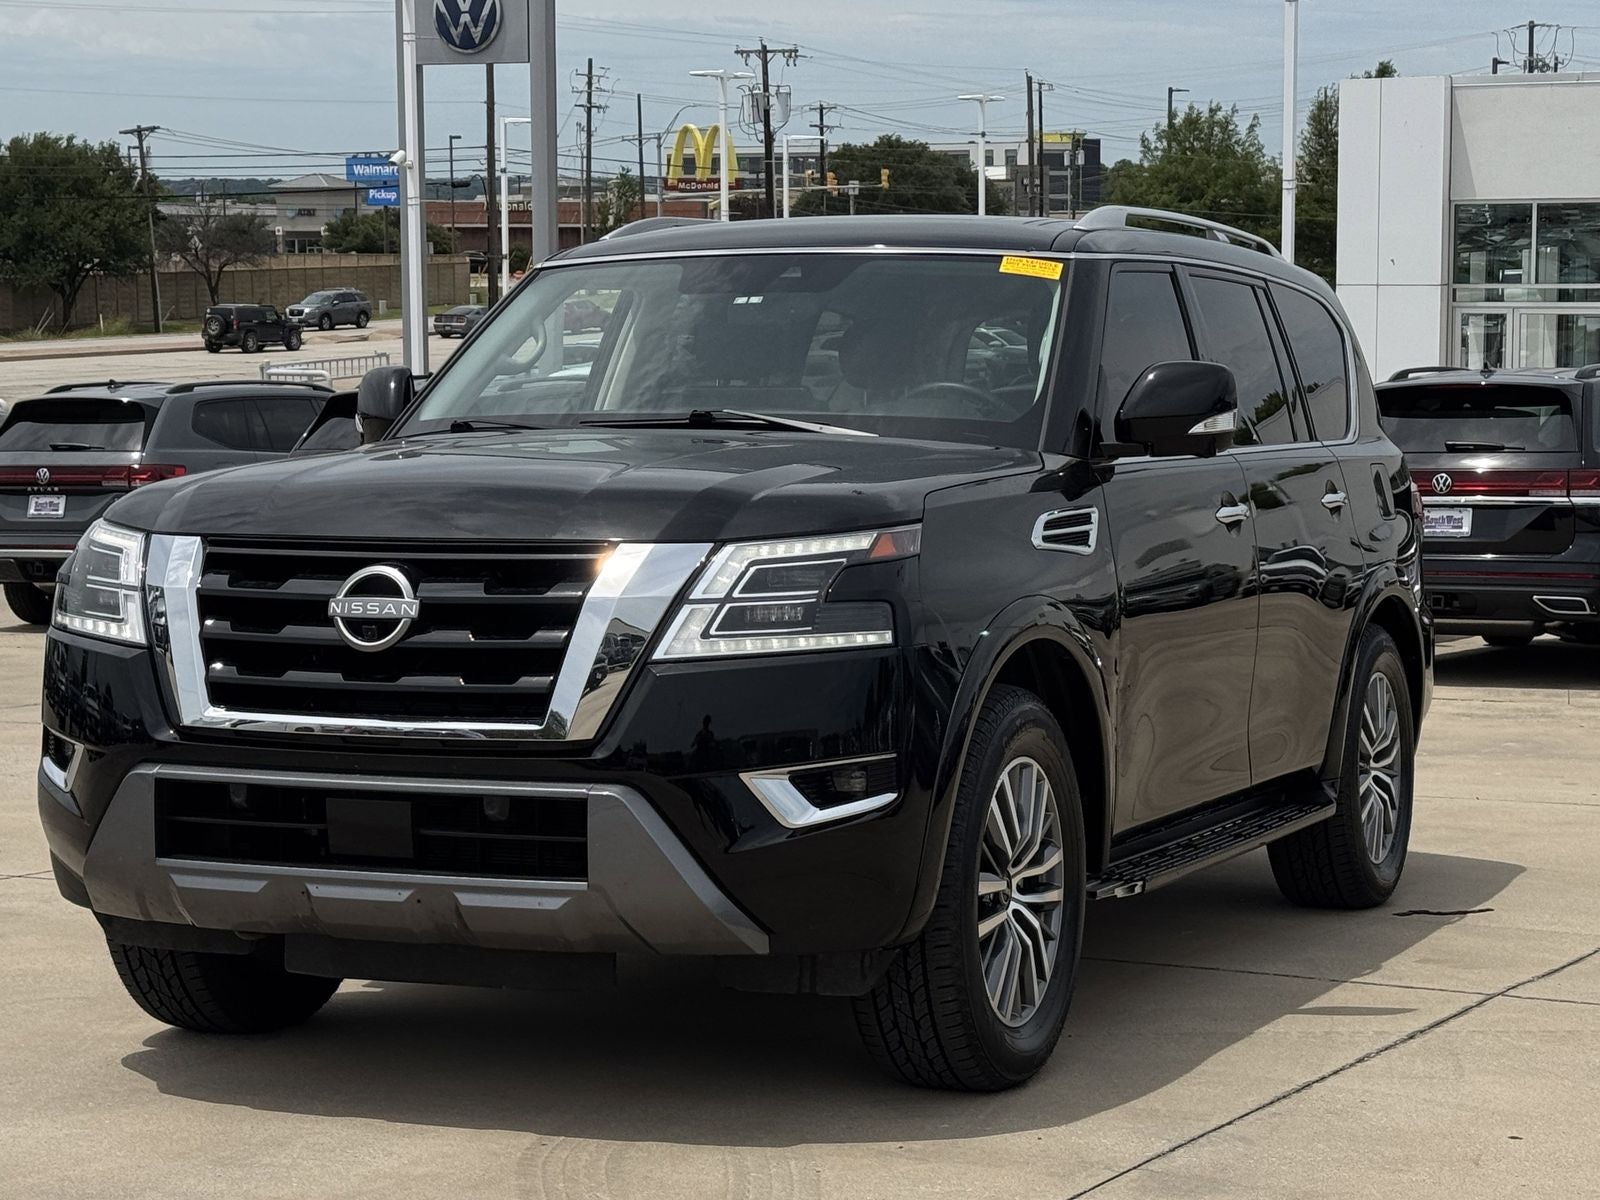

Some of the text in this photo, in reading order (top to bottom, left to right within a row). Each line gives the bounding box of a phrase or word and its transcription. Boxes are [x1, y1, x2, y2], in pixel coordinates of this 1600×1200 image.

[353, 164, 399, 176] Walmart
[678, 182, 719, 190] McDonald
[369, 189, 397, 201] Pickup
[330, 602, 416, 615] NISSAN
